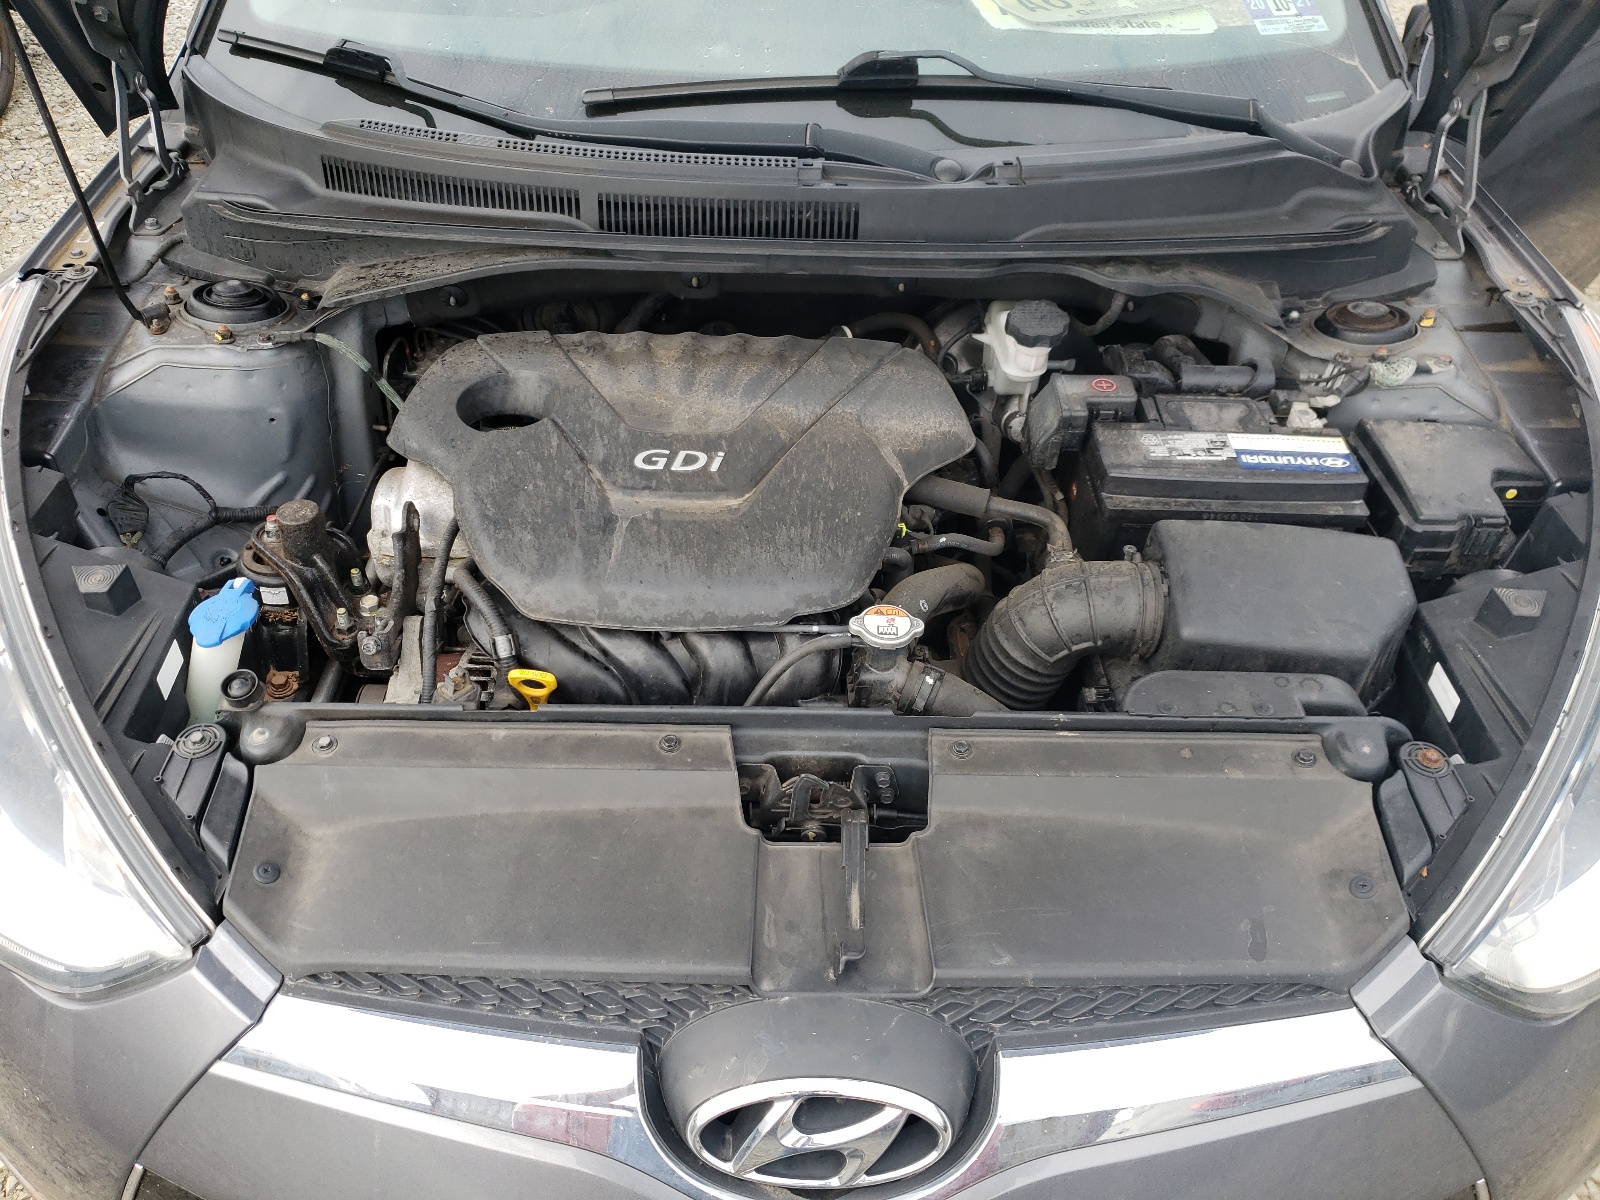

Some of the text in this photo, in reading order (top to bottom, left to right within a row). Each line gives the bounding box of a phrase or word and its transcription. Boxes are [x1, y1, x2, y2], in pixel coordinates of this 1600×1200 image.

[1115, 18, 1162, 29] State
[634, 449, 726, 472] GDi
[1240, 453, 1320, 466] HYUNDAI
